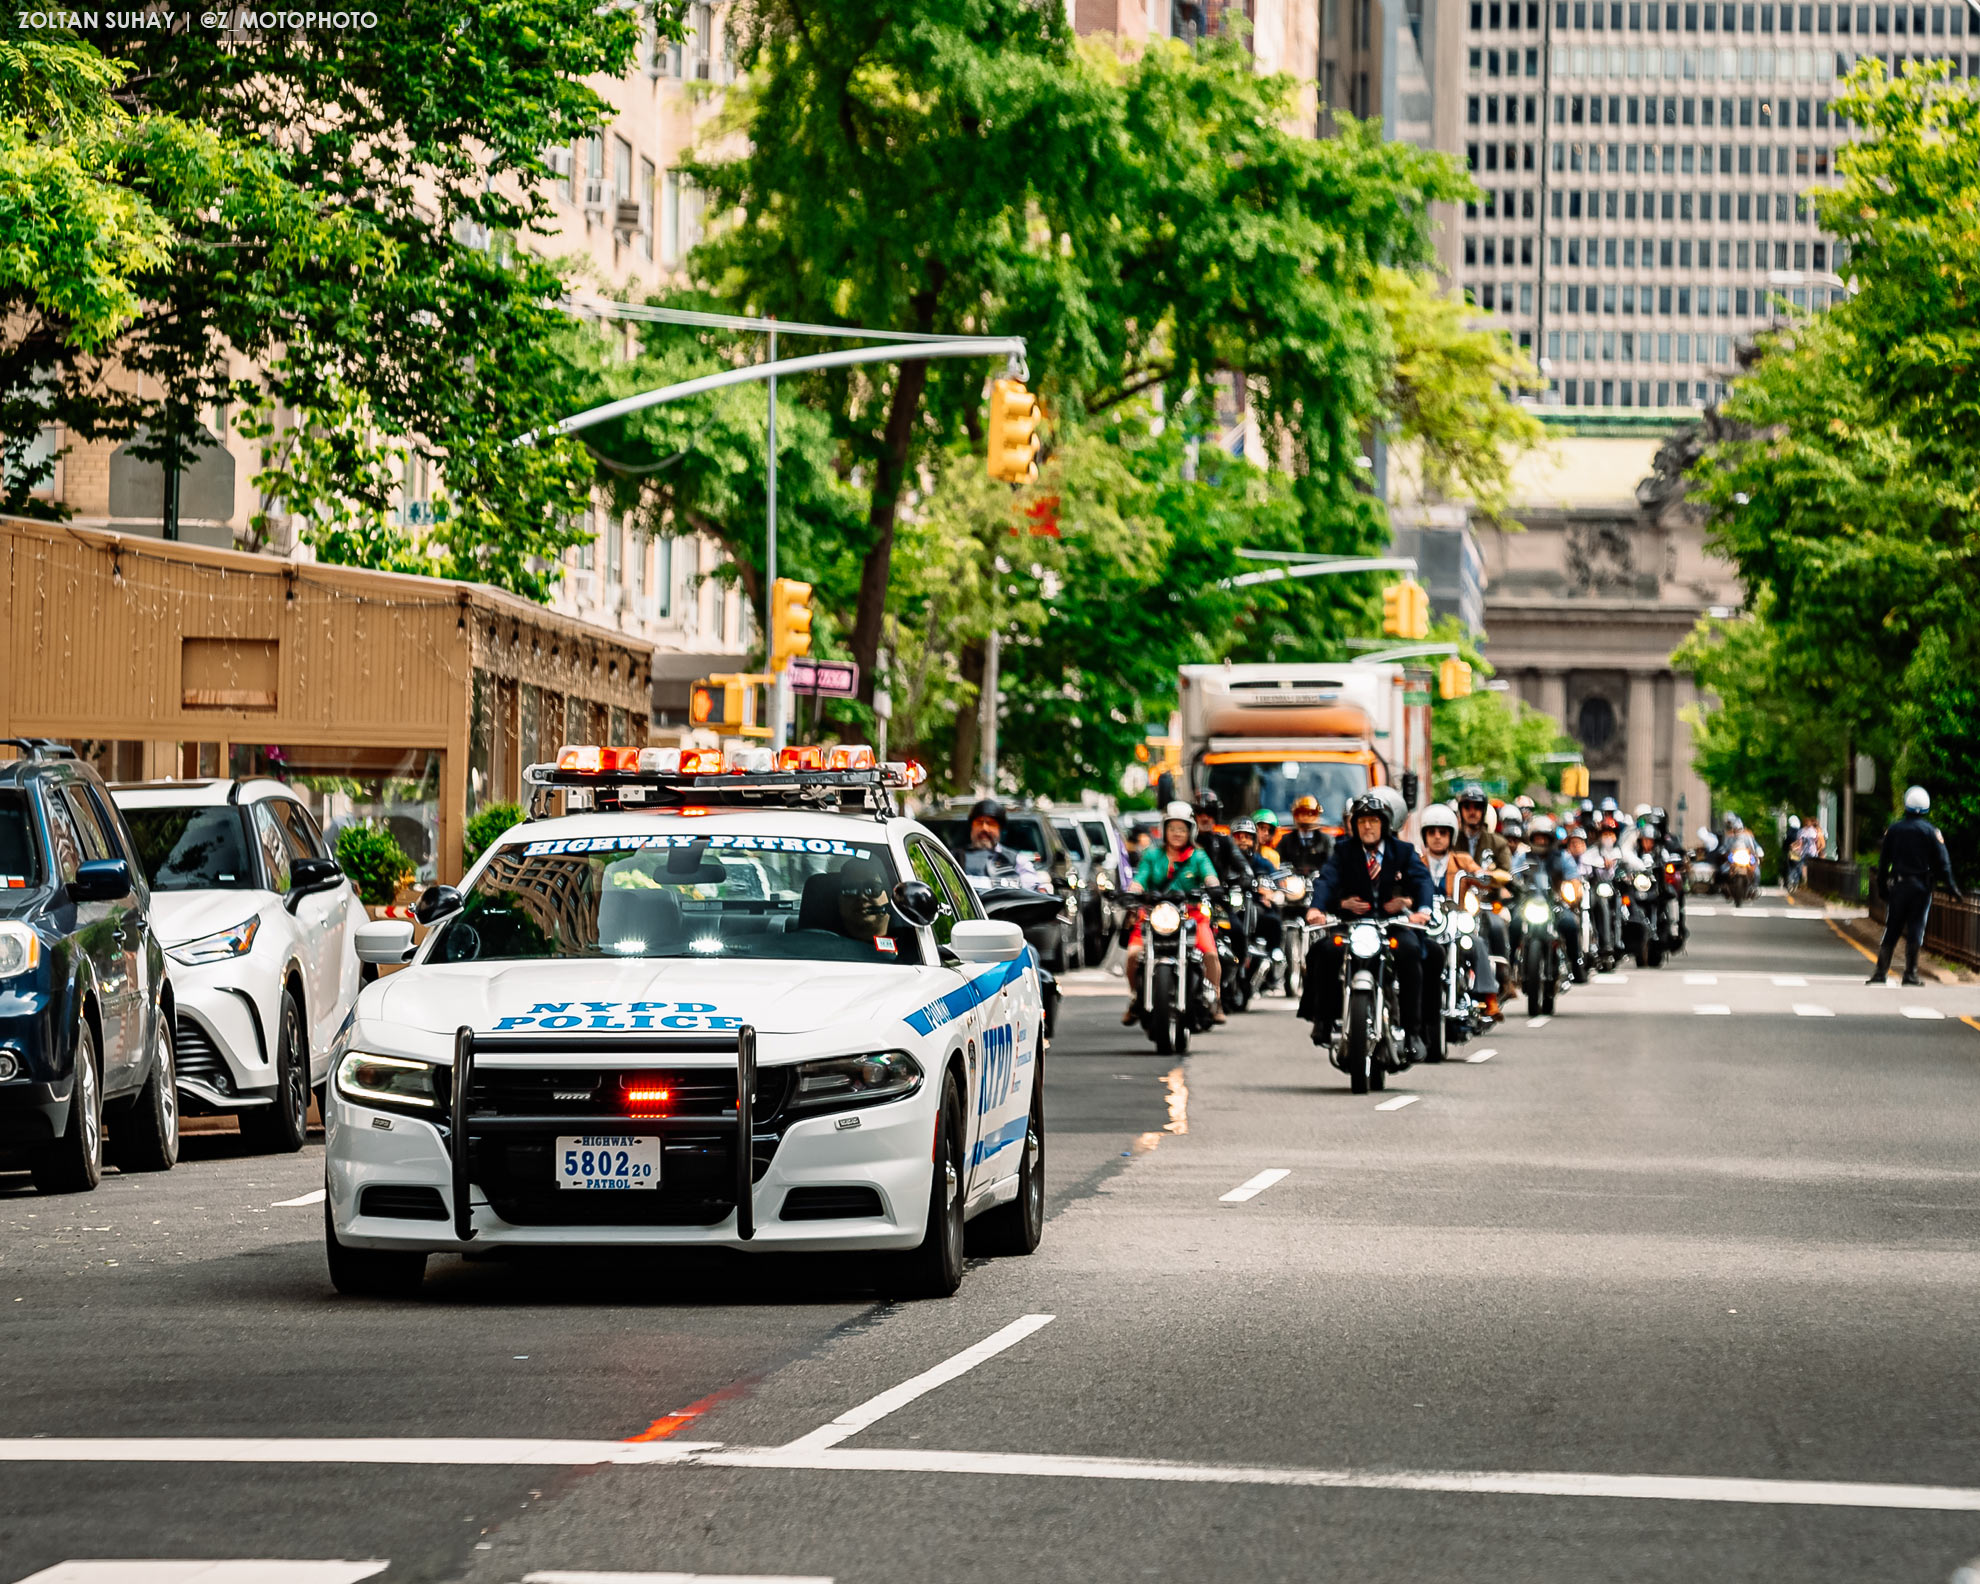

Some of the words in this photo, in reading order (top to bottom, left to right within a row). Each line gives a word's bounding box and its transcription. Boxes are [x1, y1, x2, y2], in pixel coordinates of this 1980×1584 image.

[523, 835, 698, 857] HIGHWAY
[709, 835, 856, 857] PATROL
[526, 1001, 718, 1014] NYPD
[491, 1015, 744, 1030] POLICE
[582, 1136, 635, 1146] HIGHWAY
[586, 1179, 631, 1189] PATROL
